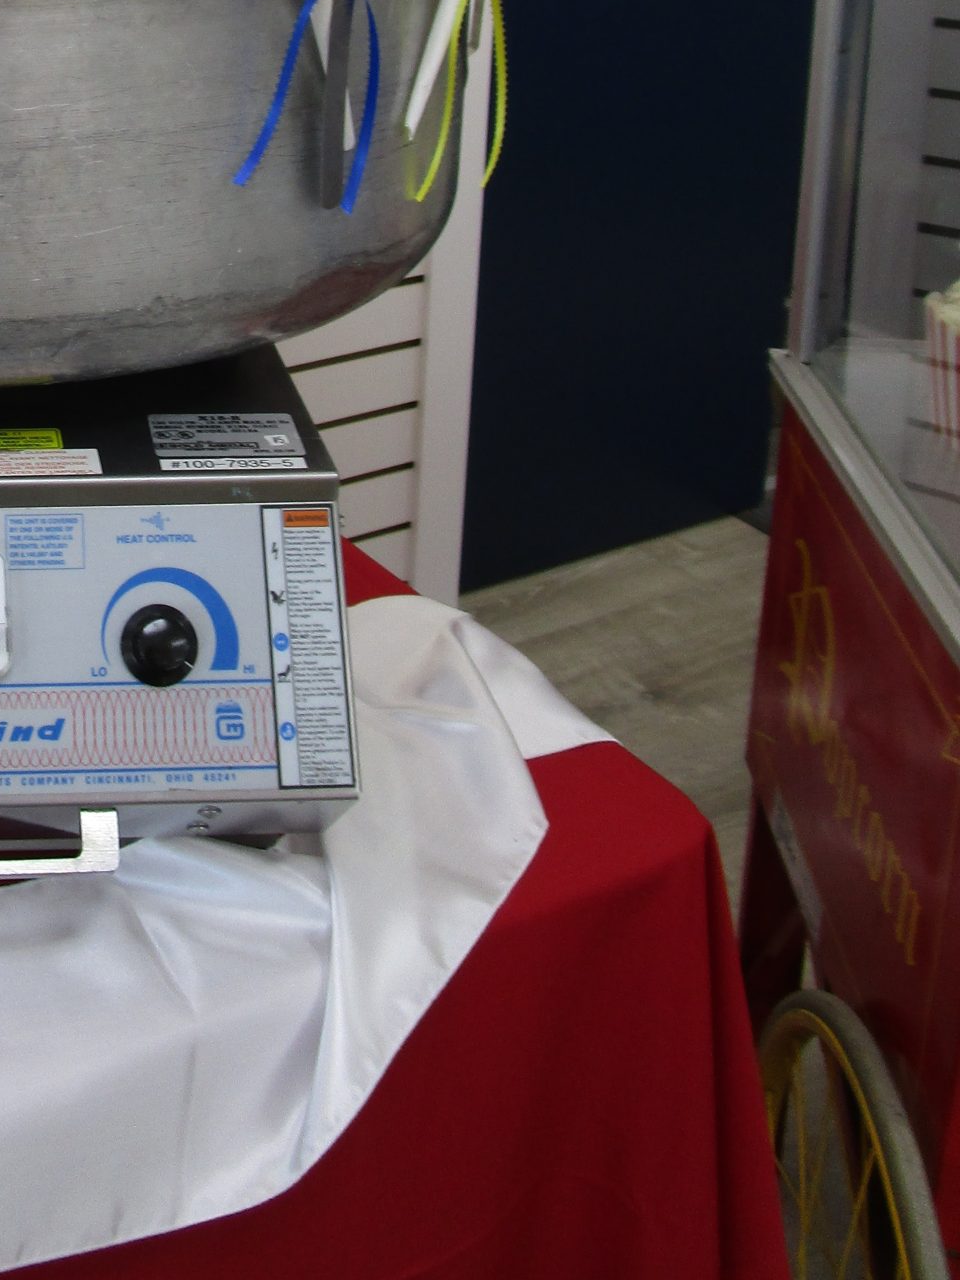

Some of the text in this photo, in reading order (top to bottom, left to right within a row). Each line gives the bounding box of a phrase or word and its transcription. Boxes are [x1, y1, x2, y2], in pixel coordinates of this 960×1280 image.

[171, 459, 294, 469] #100-7935-5
[116, 534, 197, 544] HEAT CONTROL
[91, 667, 108, 677] LO
[243, 664, 256, 674] HI
[21, 776, 75, 786] COMPANY
[85, 774, 156, 785] CINCINNATI,
[166, 773, 194, 783] OHIO
[202, 772, 238, 783] 45241
